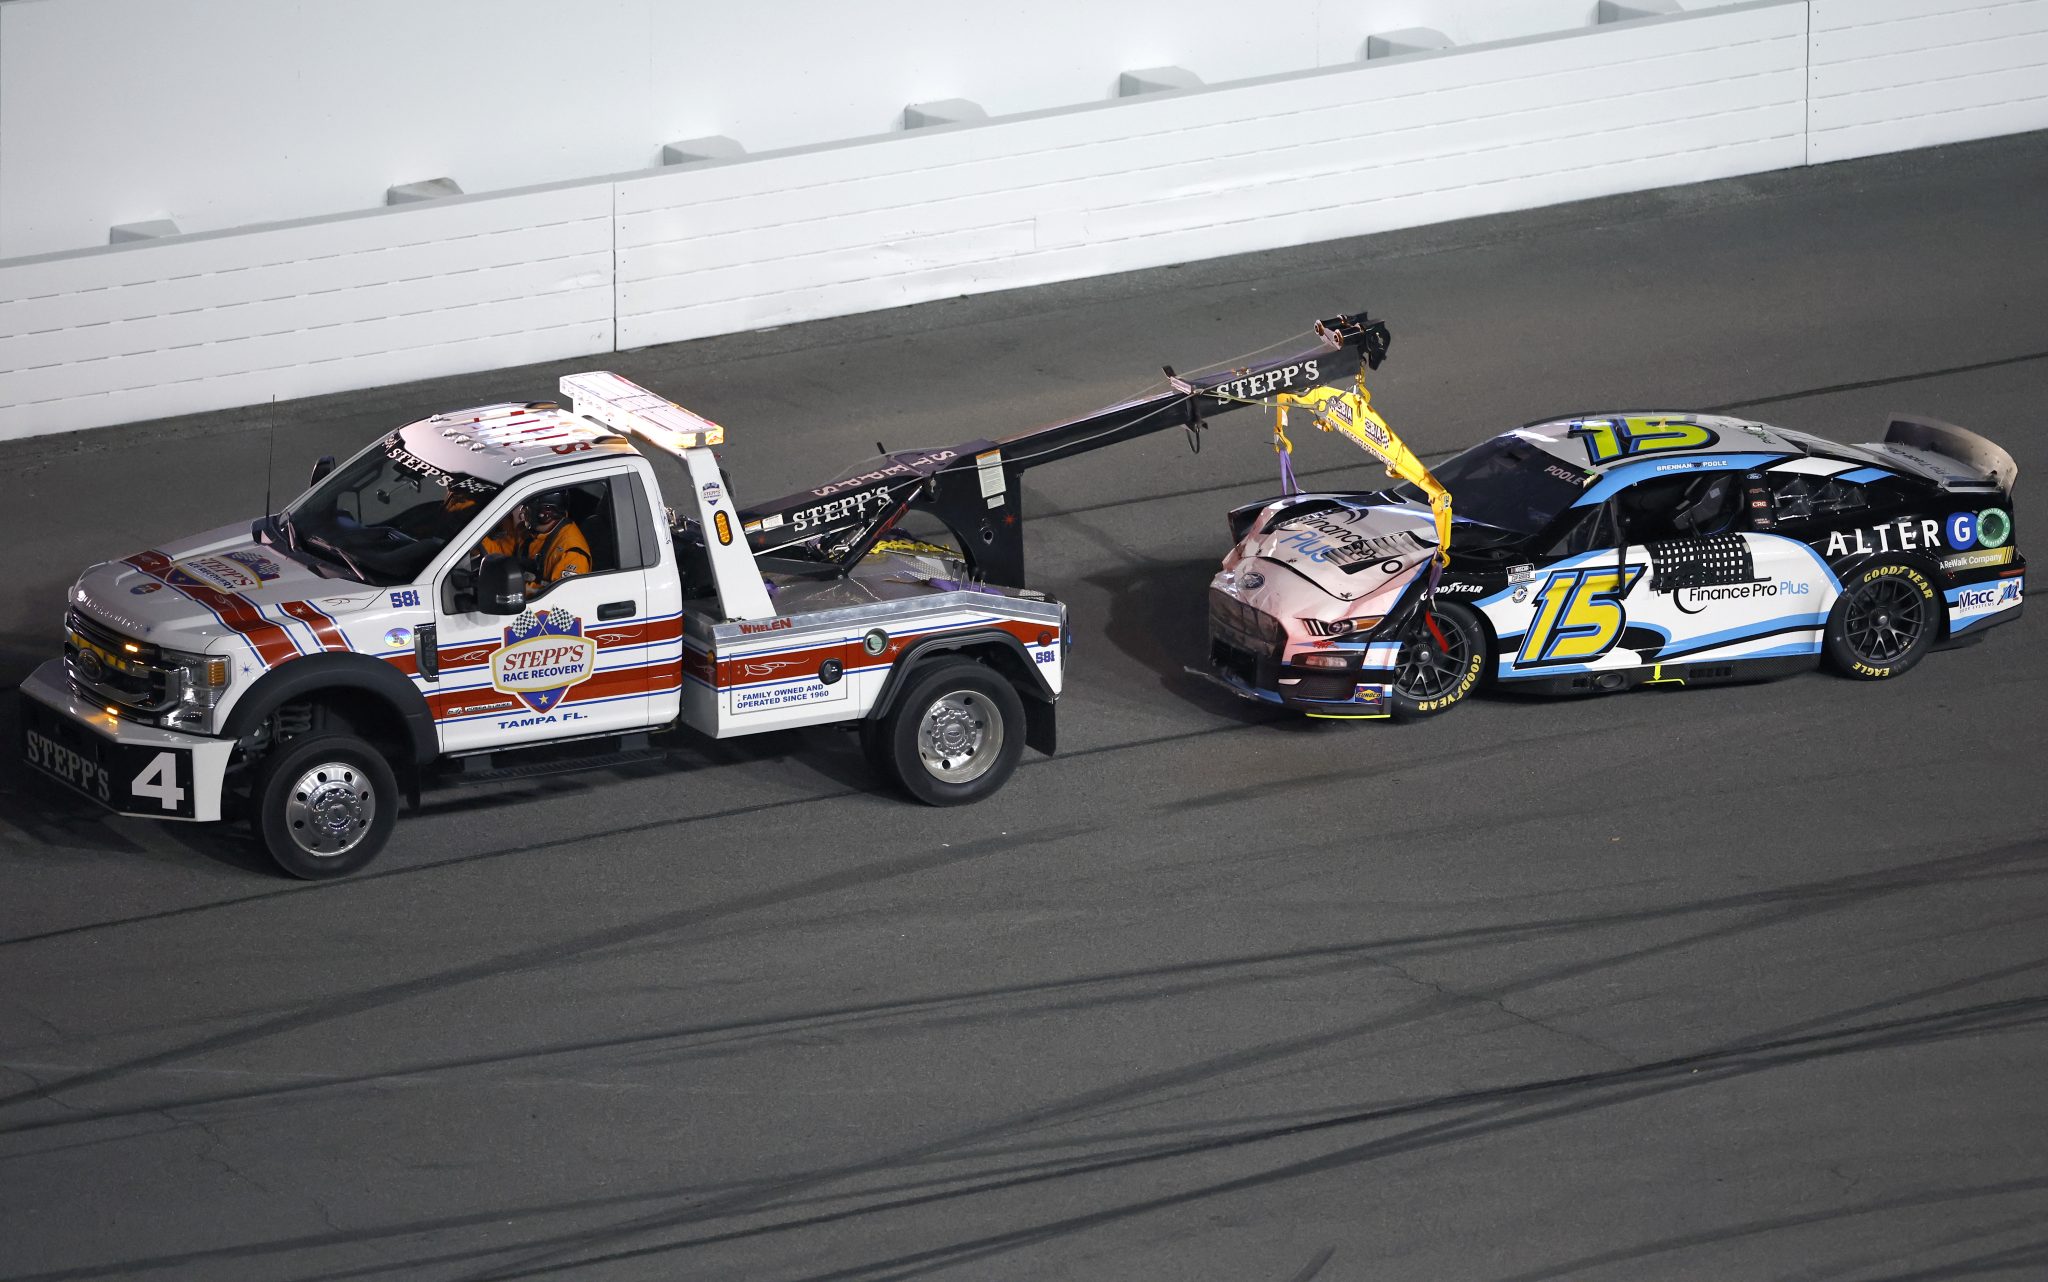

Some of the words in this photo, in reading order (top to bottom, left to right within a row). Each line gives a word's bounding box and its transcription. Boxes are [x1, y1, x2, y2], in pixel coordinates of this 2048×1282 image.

[1216, 359, 1319, 405] STEPP'S
[1567, 416, 1720, 466] 15
[388, 448, 454, 487] STEPP'S
[1544, 465, 1585, 486] POOLE
[1656, 463, 1692, 472] BRENNAN
[792, 486, 890, 532] STEPP'S
[1280, 530, 1336, 563] Plus
[1940, 561, 1945, 570] A
[1945, 557, 1968, 568] ReWalk
[1969, 553, 2002, 565] Company
[390, 590, 420, 608] 581
[1420, 582, 1483, 600] GODYEAR
[1689, 586, 1750, 602] Finance
[1752, 583, 1777, 597] Pro
[1779, 581, 1809, 595] Plus
[1960, 590, 1994, 609] Macc
[739, 618, 792, 634] WHELEN
[1513, 563, 1648, 670] 15
[503, 644, 584, 671] STEPP'S
[1035, 650, 1055, 664] 581
[503, 671, 529, 682] RACE
[531, 664, 584, 678] RECOVERY
[1852, 661, 1890, 677] EAGLE
[737, 698, 780, 709] OPERATED
[783, 693, 807, 702] SINCE
[810, 690, 829, 699] 1960
[743, 691, 771, 701] FAMILY
[774, 686, 803, 697] OWNED
[806, 684, 823, 692] AND
[498, 715, 557, 729] TAMPA
[563, 712, 588, 721] FL.
[27, 729, 110, 801] STEPP'S
[132, 752, 184, 810] 4
